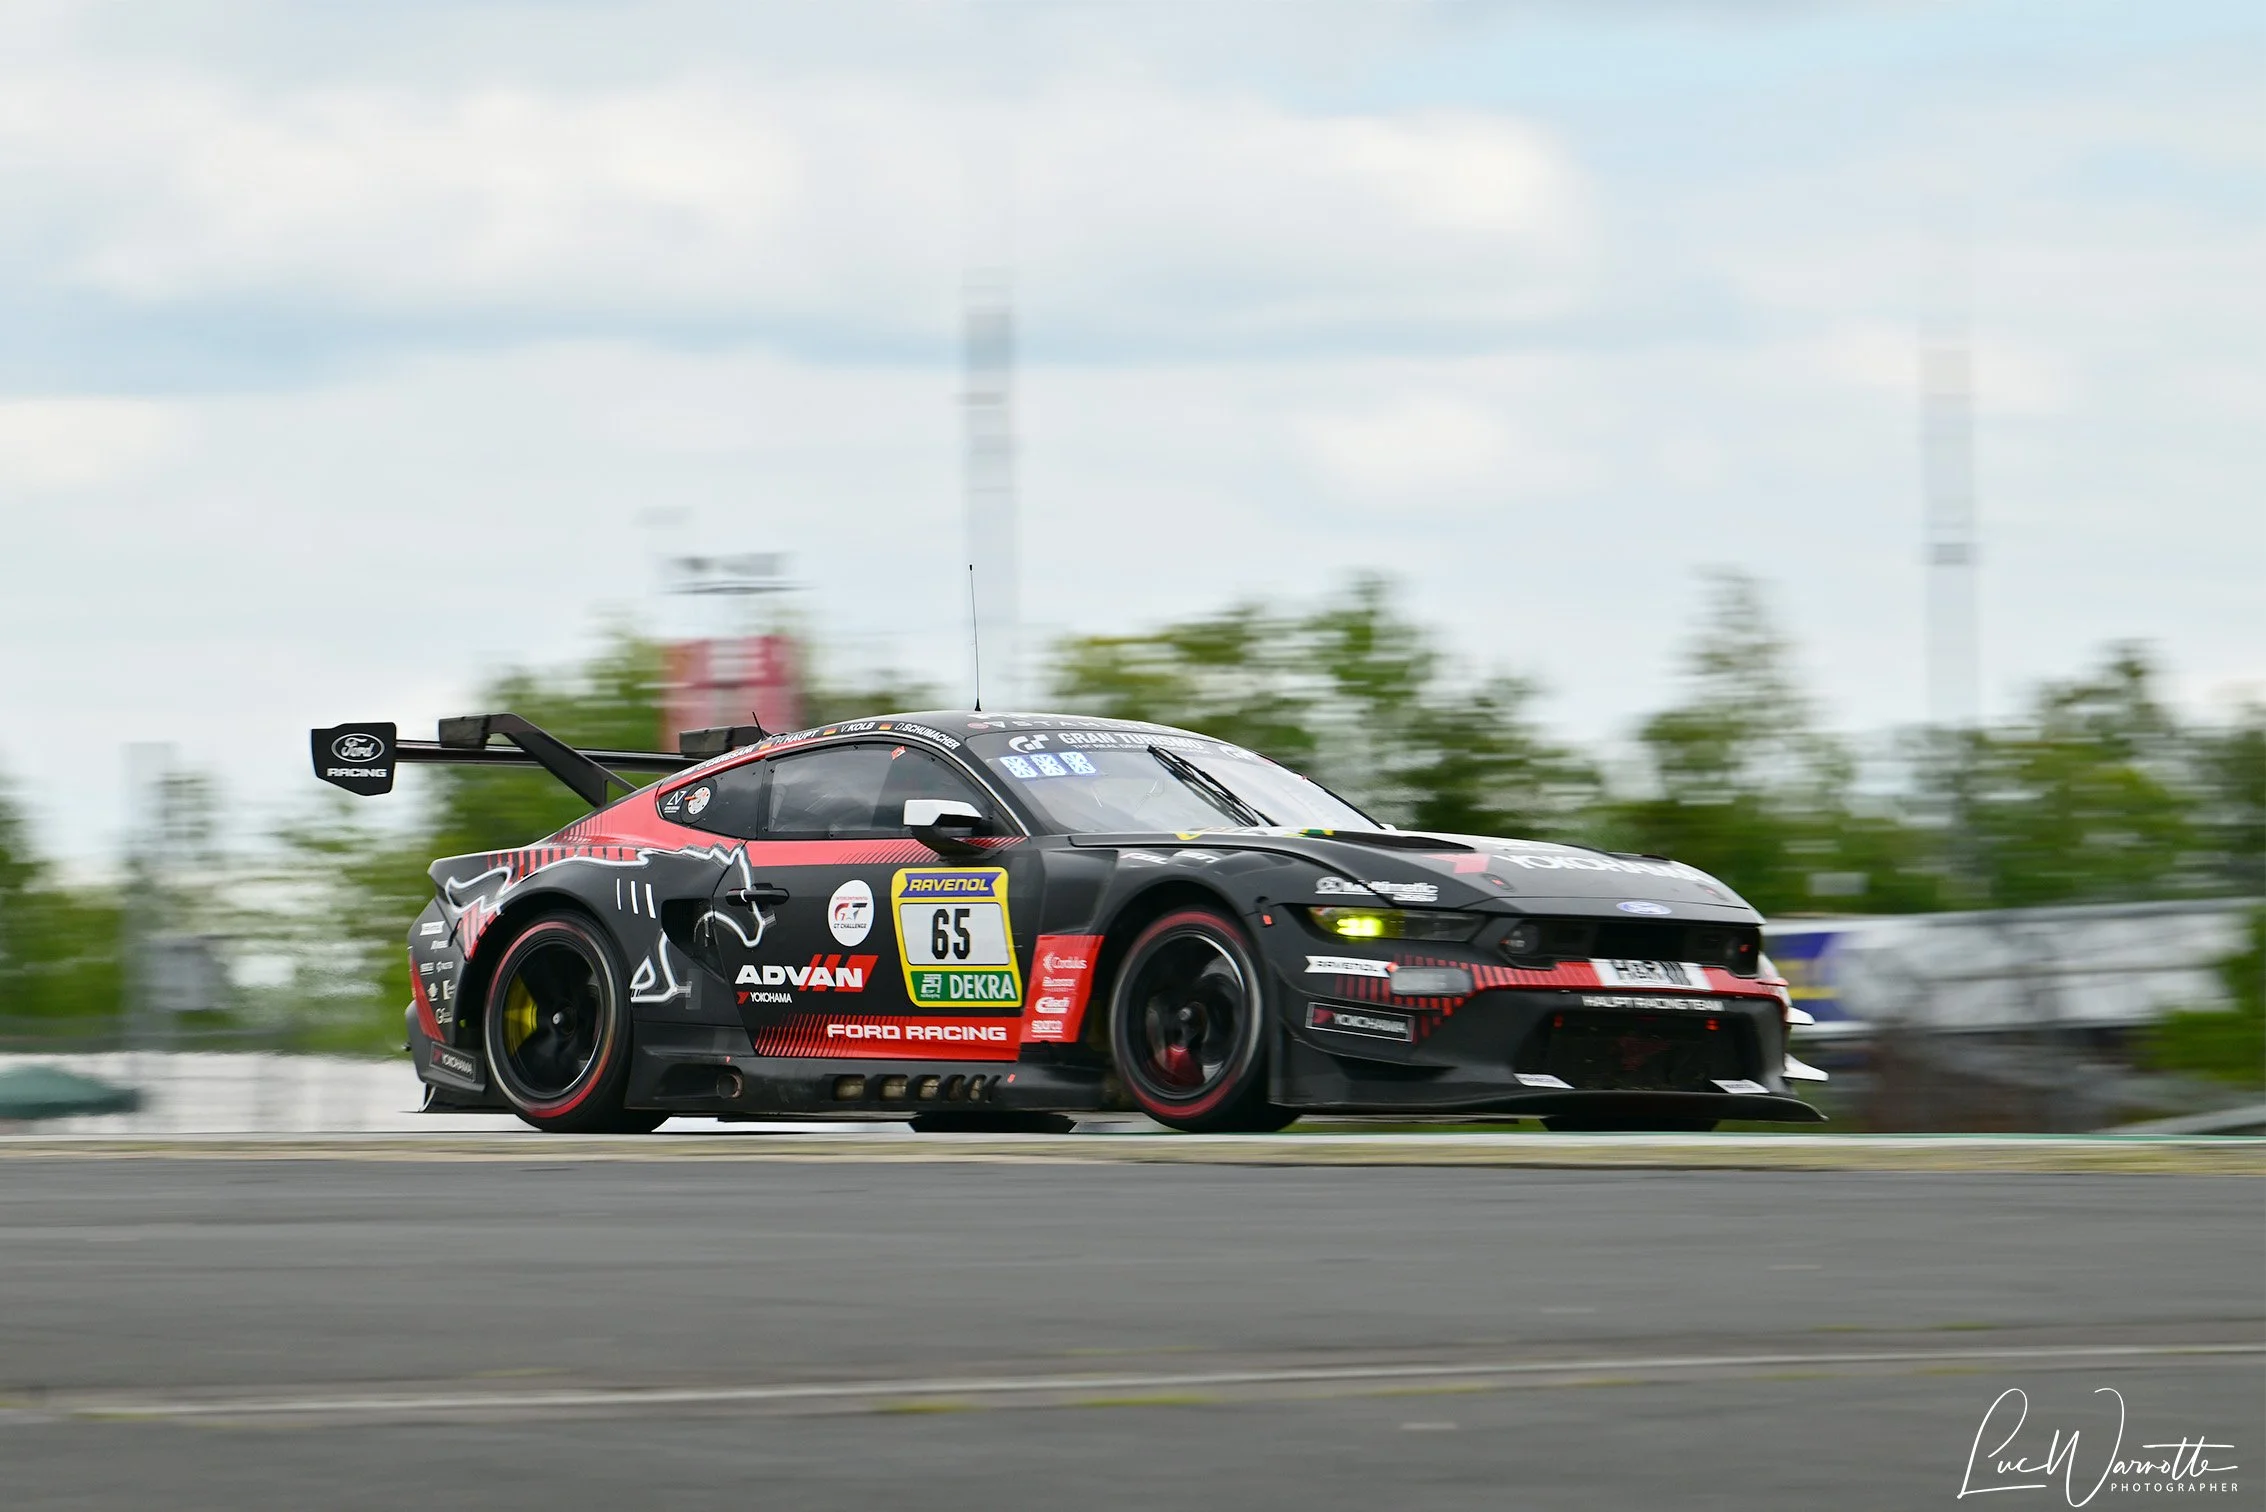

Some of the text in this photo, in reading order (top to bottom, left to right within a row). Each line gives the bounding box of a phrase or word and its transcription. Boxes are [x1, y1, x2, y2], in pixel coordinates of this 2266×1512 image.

[840, 721, 876, 733] V.KOLB
[894, 723, 961, 750] D.SCHUMACHER
[1057, 733, 1117, 746] GRAN
[1114, 733, 1205, 750] TURISMO
[341, 737, 375, 757] Ford
[327, 768, 388, 777] RACING
[1492, 854, 1727, 885] YOKOHAMA
[909, 879, 989, 892] RAVENOL
[932, 908, 970, 959] 65
[735, 965, 863, 988] ADVAN
[949, 974, 1016, 999] DEKRA
[750, 991, 792, 1003] YOKOHAMA
[827, 1024, 1007, 1041] FORD RACING
